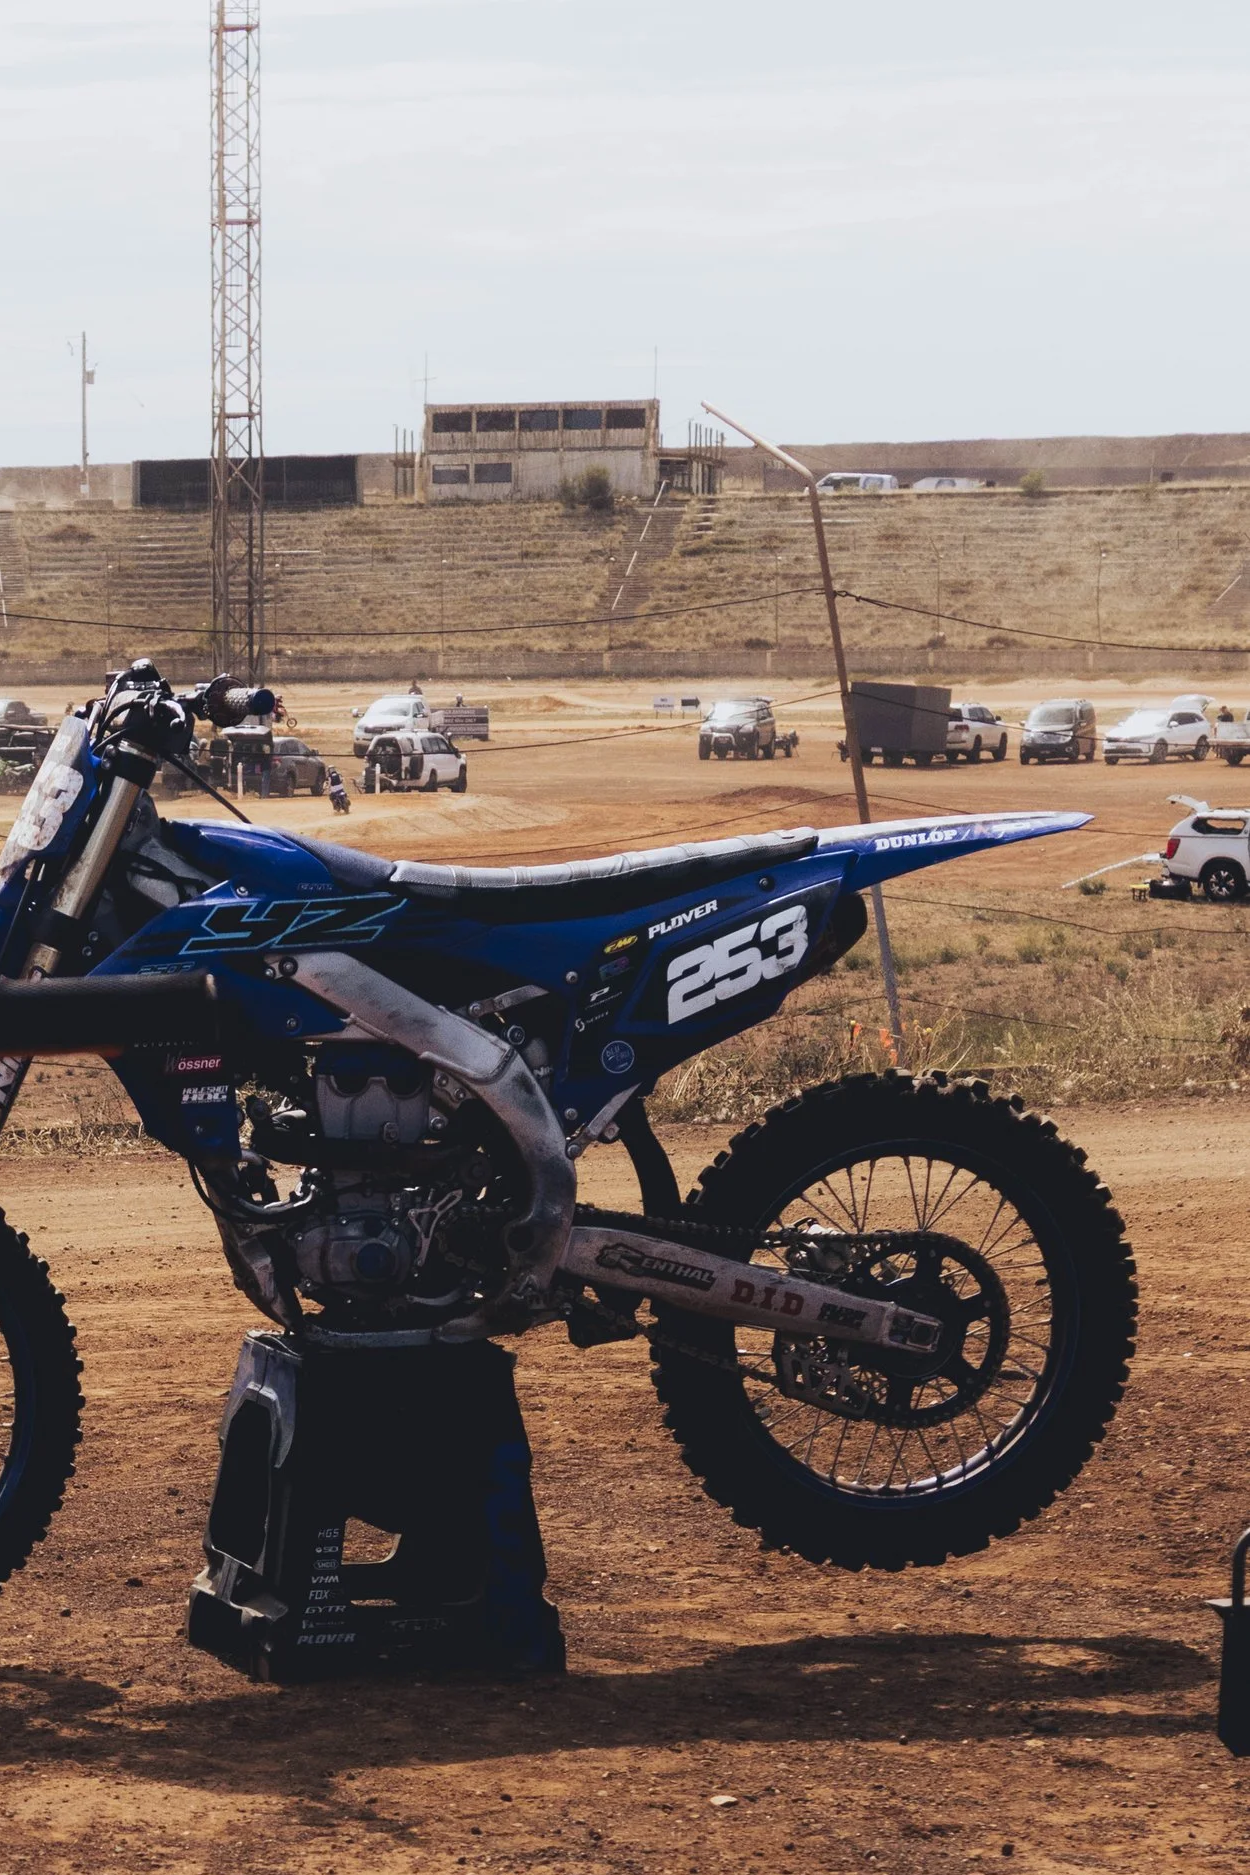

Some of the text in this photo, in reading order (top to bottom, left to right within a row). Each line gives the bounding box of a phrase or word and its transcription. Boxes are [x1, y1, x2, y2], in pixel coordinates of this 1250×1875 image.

[874, 829, 958, 850] DUNLOP
[647, 899, 719, 940] PLOVER
[667, 904, 808, 1025] 253
[164, 1050, 222, 1074] Wössner
[311, 1575, 340, 1584] VHM
[308, 1589, 330, 1601] FOX
[296, 1632, 357, 1645] PLOVER
